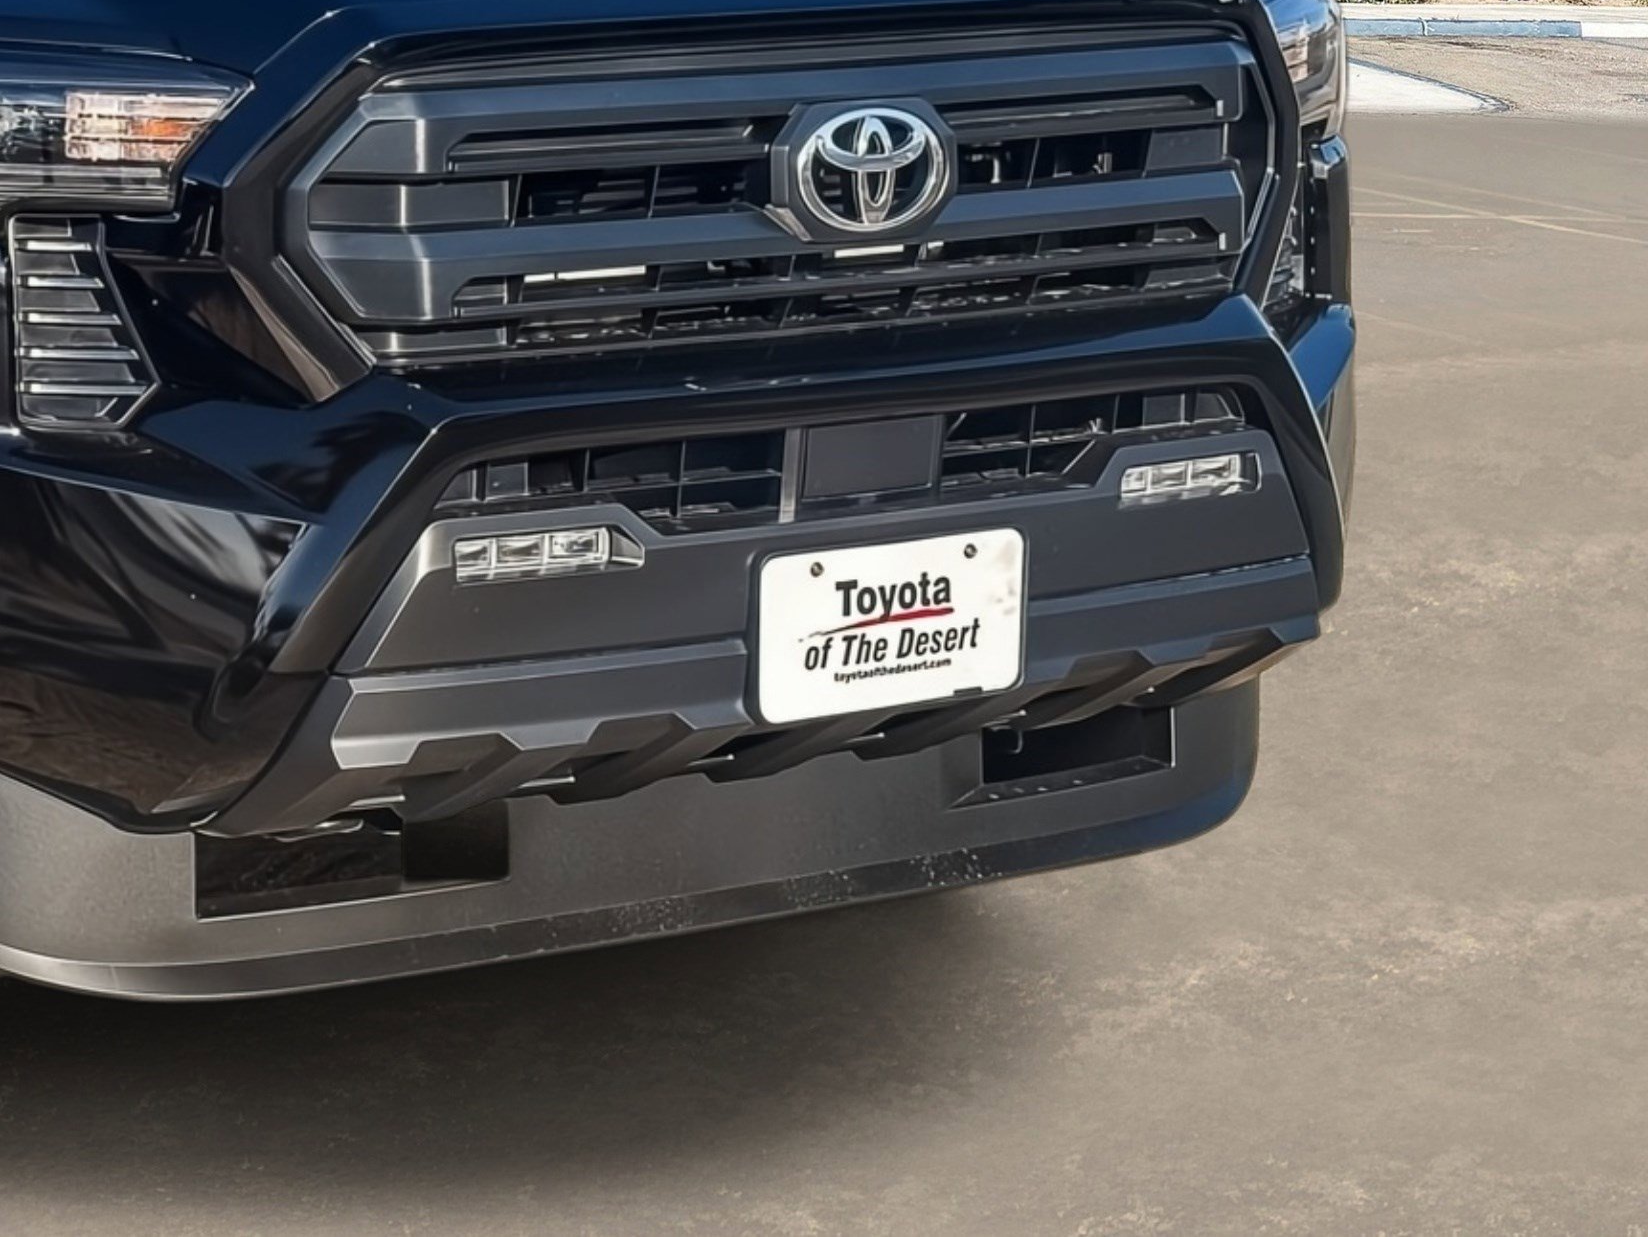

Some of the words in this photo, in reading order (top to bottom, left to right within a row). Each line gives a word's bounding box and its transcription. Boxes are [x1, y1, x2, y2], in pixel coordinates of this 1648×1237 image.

[835, 572, 952, 622] Toyota
[804, 637, 834, 671] of
[842, 632, 889, 666] The
[896, 617, 981, 659] Desert
[834, 658, 952, 684] toyotaofthedesert.com
